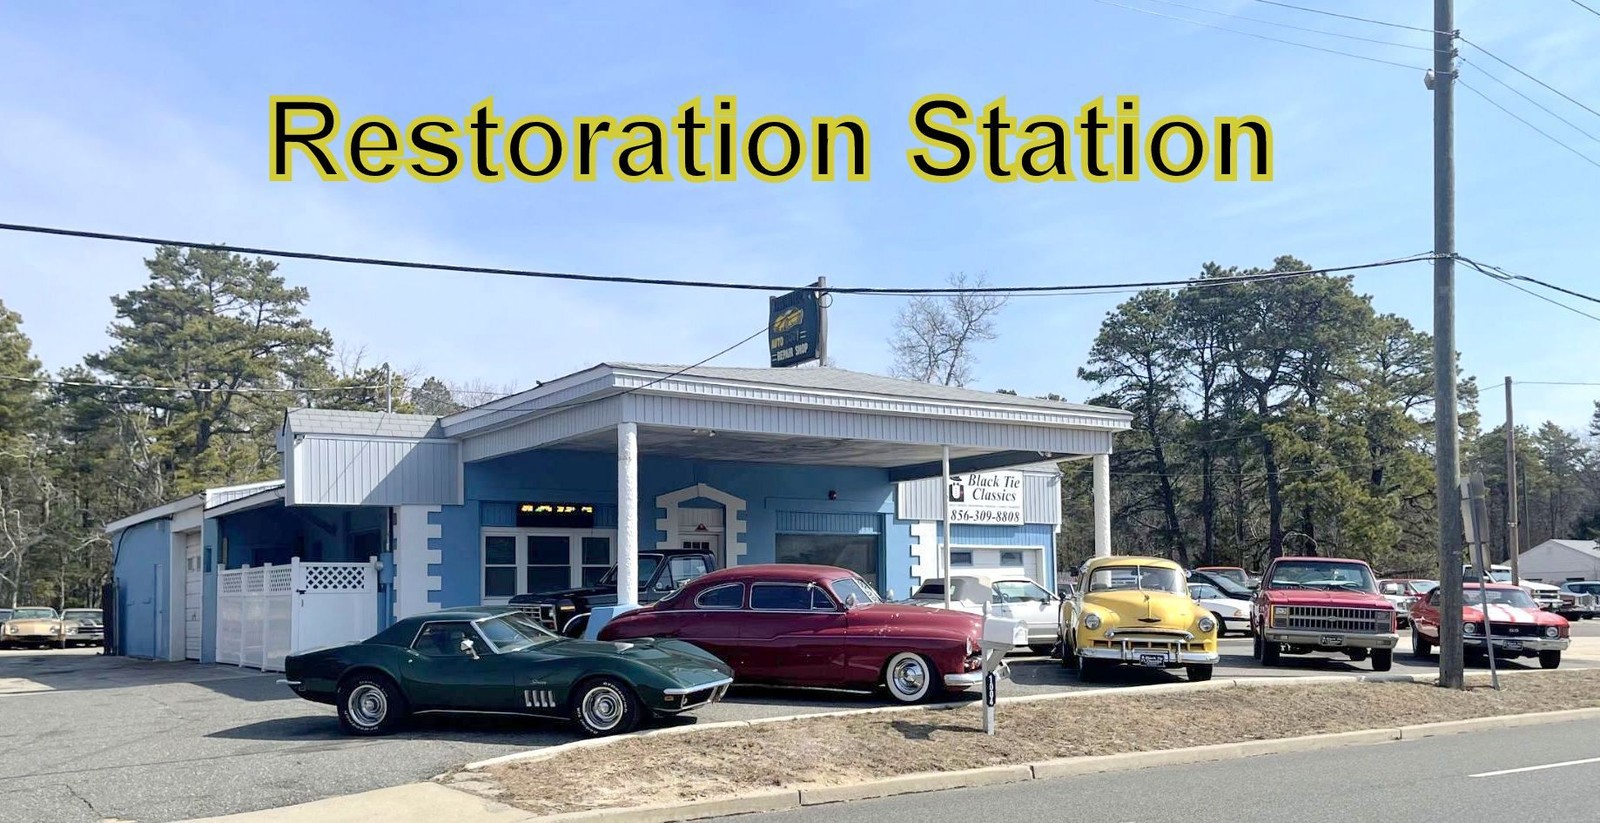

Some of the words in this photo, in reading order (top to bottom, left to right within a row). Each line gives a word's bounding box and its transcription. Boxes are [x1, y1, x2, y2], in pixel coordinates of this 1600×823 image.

[795, 342, 809, 356] SHOP
[968, 473, 1000, 487] Black
[1004, 475, 1020, 488] Tie
[972, 487, 1016, 501] Classics
[950, 509, 1020, 522] 856-309-8808
